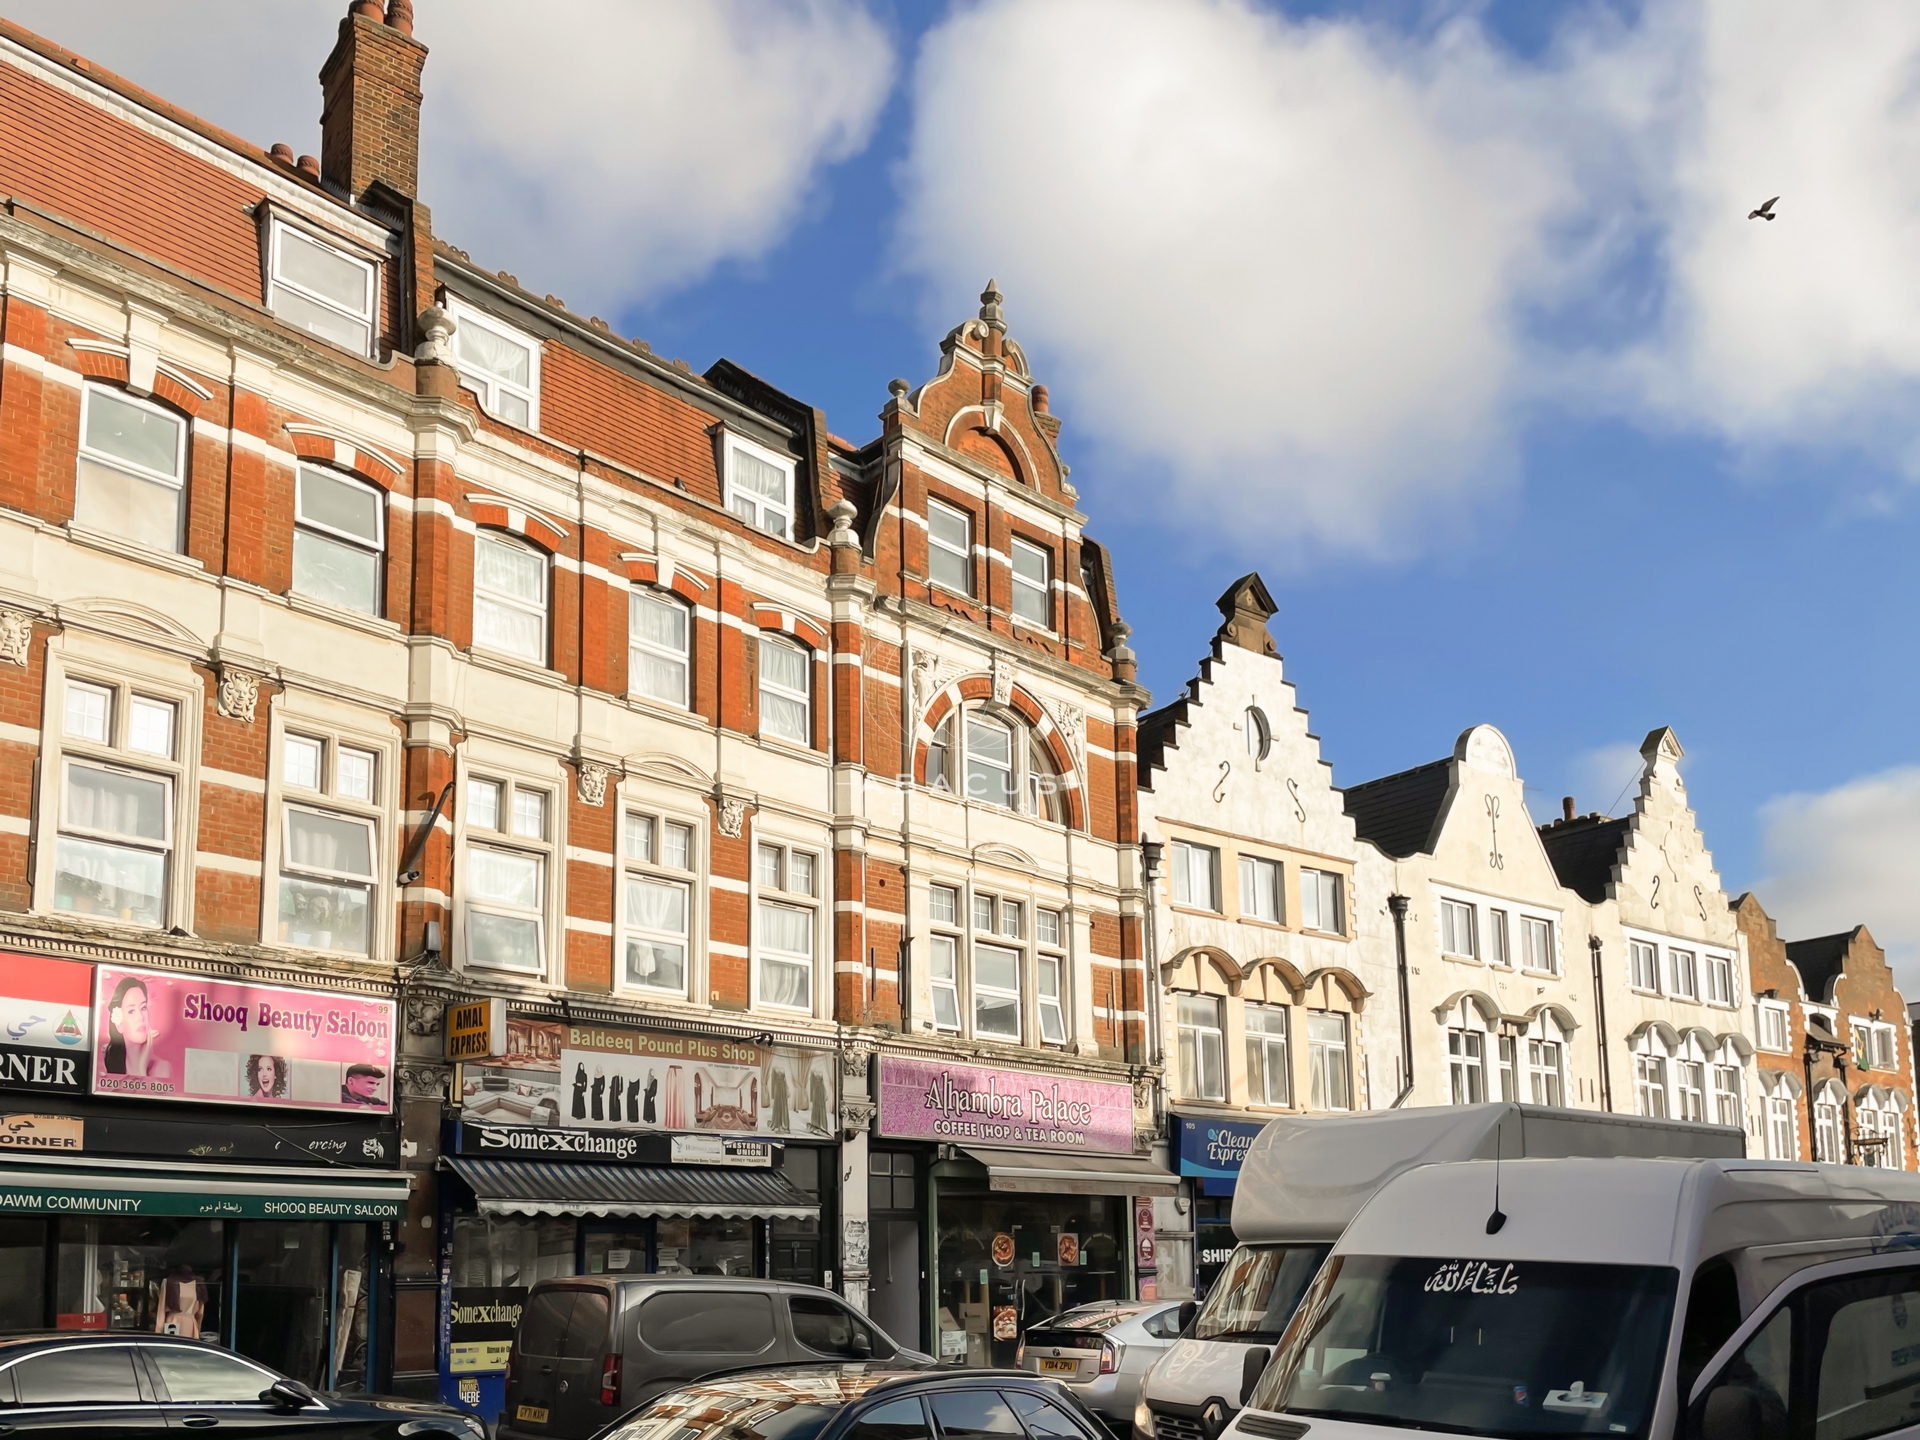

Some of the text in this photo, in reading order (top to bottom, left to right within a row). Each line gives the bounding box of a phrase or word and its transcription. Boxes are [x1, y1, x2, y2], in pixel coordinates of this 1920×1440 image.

[184, 994, 388, 1038] Shooq Beauty Saloon
[378, 1005, 389, 1014] 99
[456, 1007, 483, 1030] AMAL
[450, 1031, 487, 1056] EXPRESS
[570, 1028, 756, 1064] Baldeeq Pound Plus Shop
[100, 1079, 175, 1092] 020 3605 8005
[925, 1071, 1092, 1128] Alhambra Palace
[933, 1120, 1085, 1146] COFFEE SHOP & TEA ROOM
[1185, 1122, 1196, 1130] 105
[0, 1194, 142, 1211] AWM COMMUNITY
[264, 1202, 398, 1216] SHOOQ BEAUTY SALOON
[461, 1391, 481, 1404] HERE
